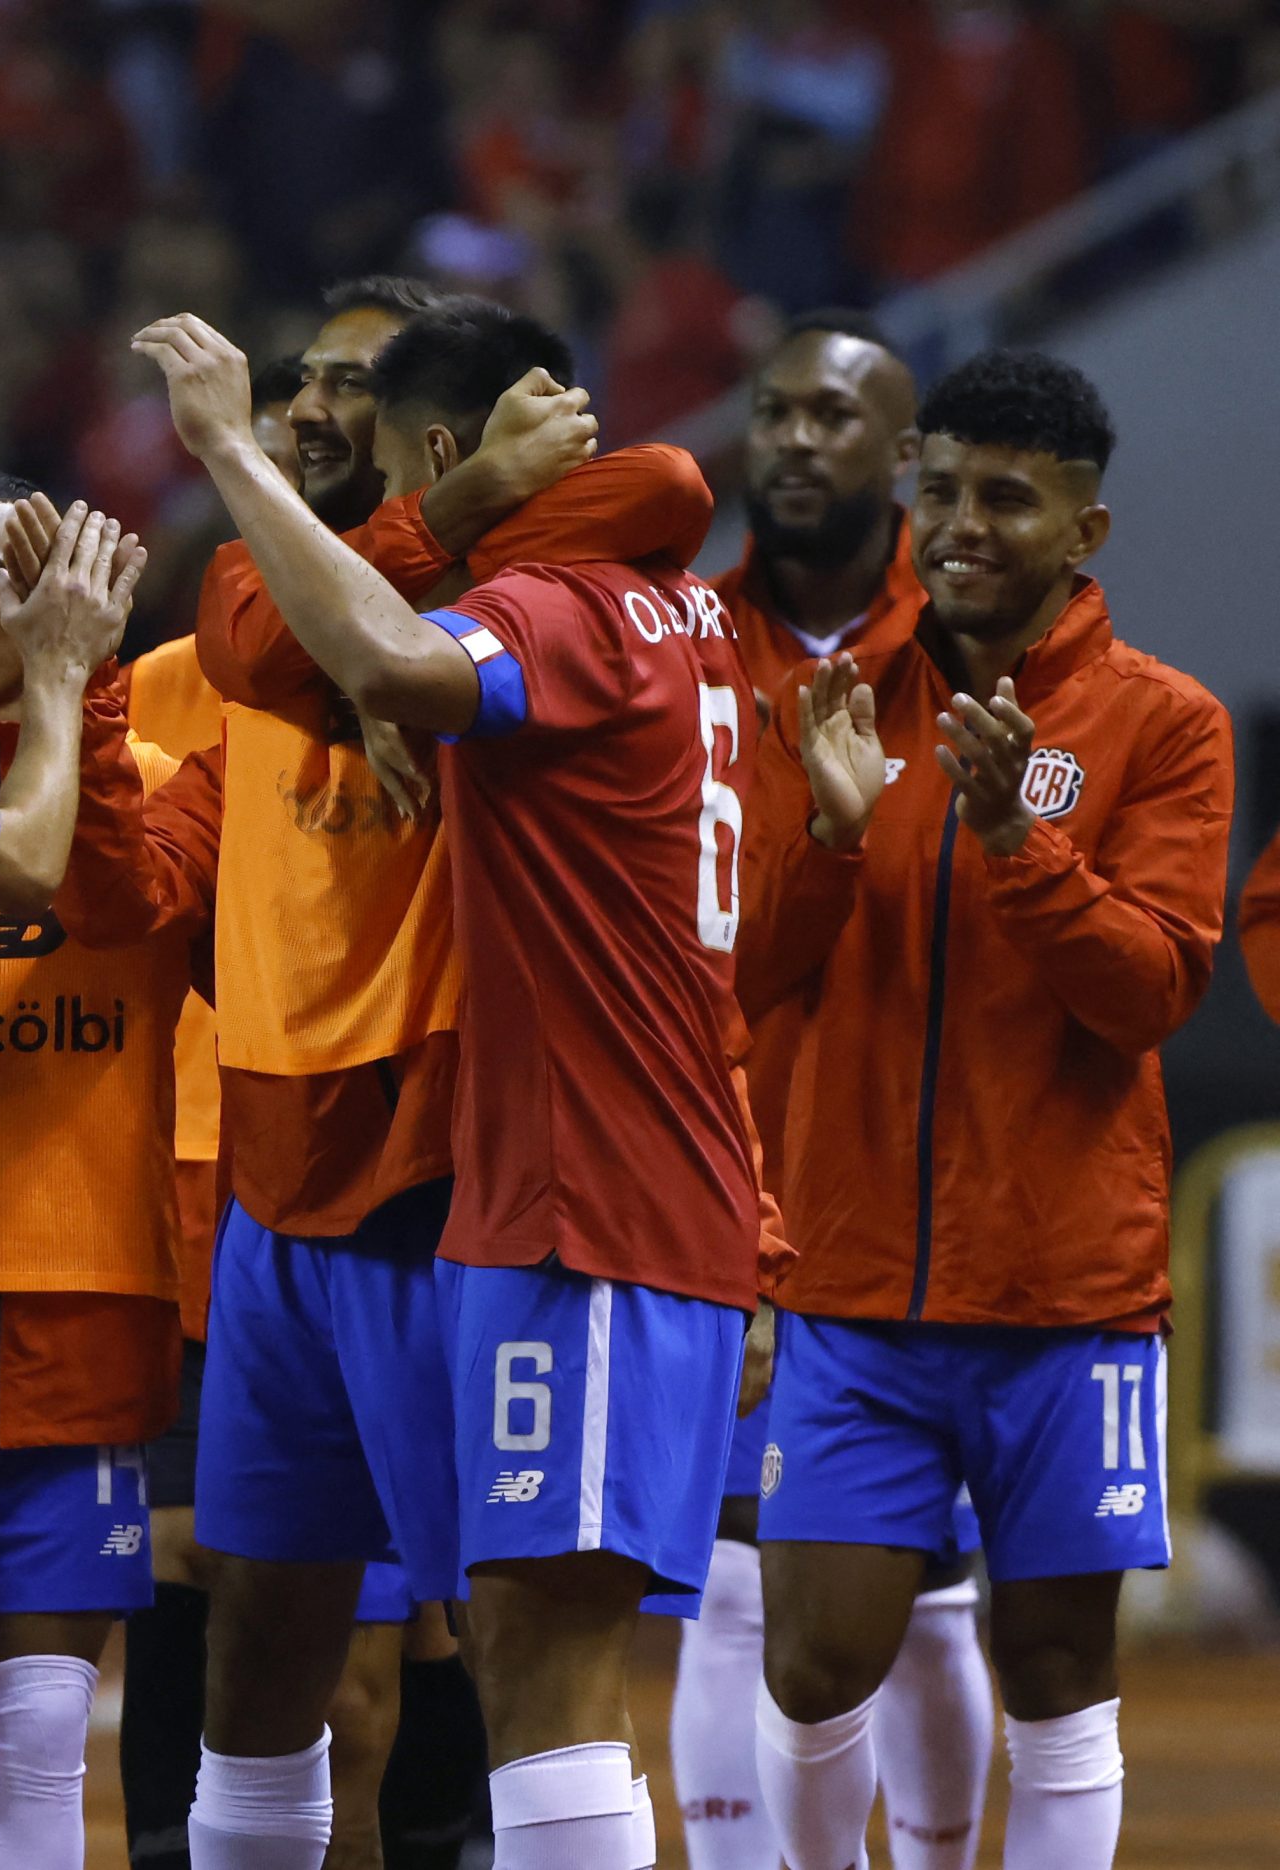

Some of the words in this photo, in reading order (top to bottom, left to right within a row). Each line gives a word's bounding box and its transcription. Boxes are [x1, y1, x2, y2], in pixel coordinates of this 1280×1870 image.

[697, 682, 744, 953] 6
[493, 1341, 553, 1451] 6
[1090, 1363, 1147, 1470] 11
